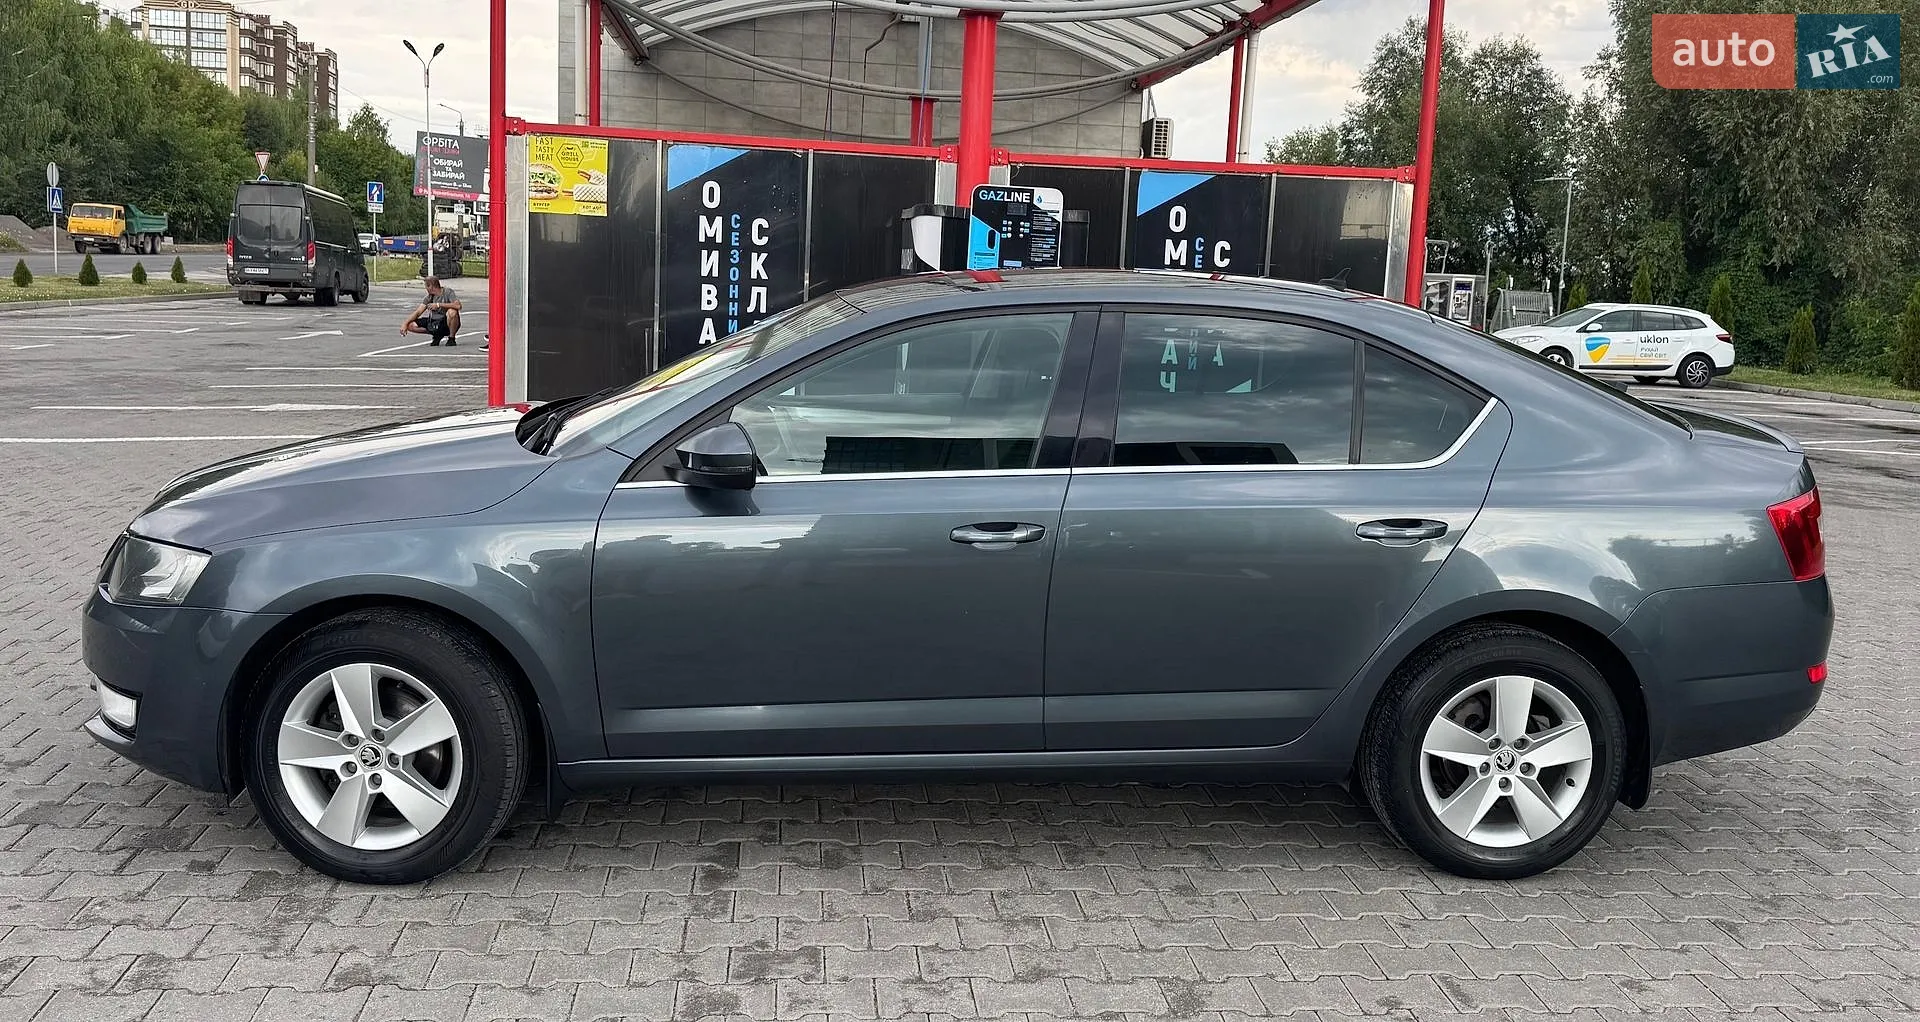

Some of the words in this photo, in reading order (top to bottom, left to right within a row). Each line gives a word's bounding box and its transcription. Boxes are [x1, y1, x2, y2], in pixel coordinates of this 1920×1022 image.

[422, 136, 460, 149] ОРБІТА
[535, 136, 554, 145] FAST
[535, 145, 555, 154] TASTY
[535, 153, 553, 161] MEAT
[979, 190, 1031, 203] GAZLINE
[747, 217, 769, 326] СКЛ
[1640, 334, 1669, 344] uklon
